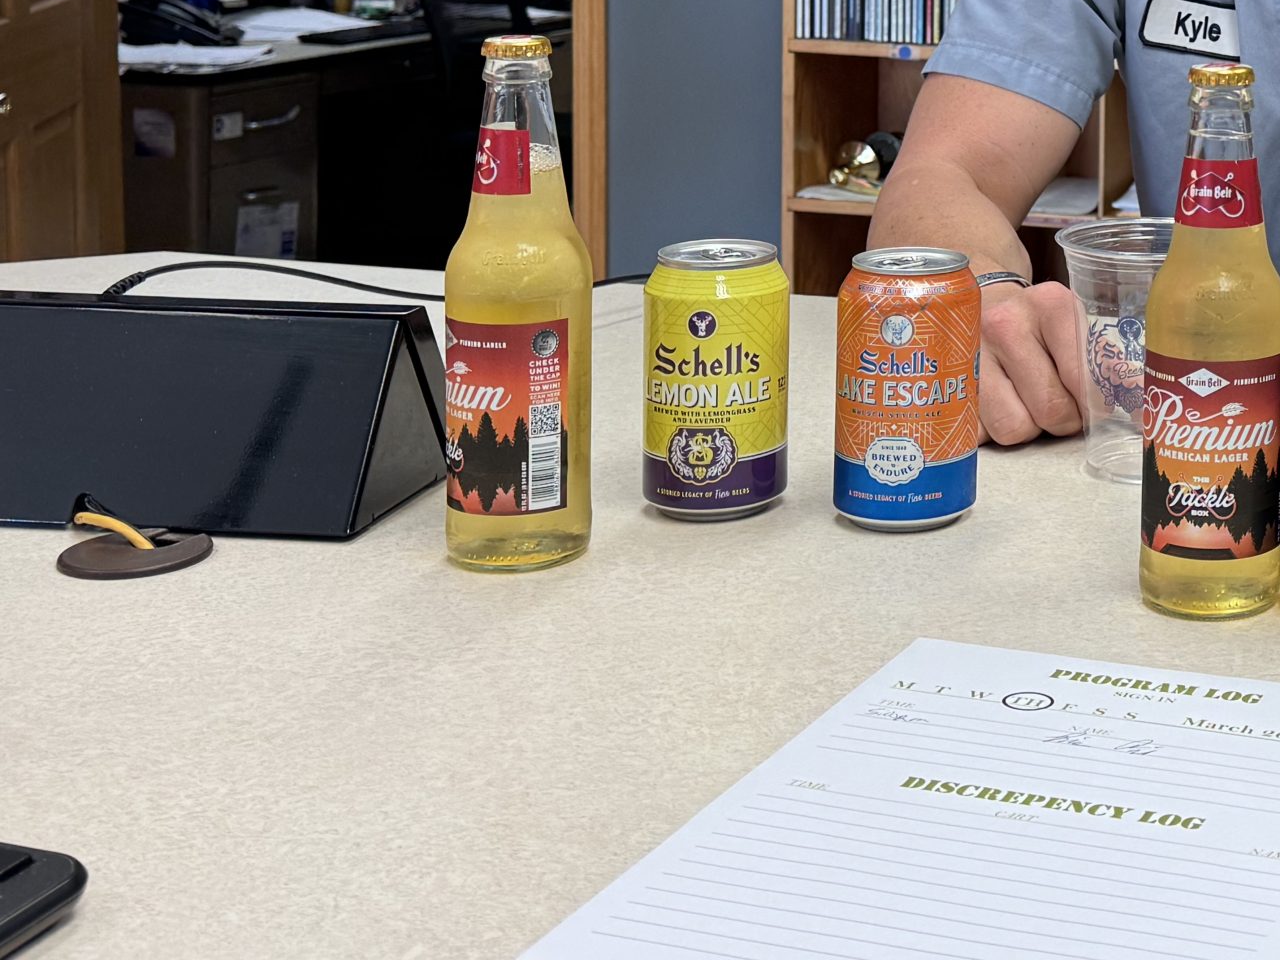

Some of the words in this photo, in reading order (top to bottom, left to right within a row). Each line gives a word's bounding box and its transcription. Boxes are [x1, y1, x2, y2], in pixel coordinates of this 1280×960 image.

[1174, 11, 1222, 42] Kyle
[1190, 184, 1212, 198] Grain
[1214, 185, 1232, 199] Belt
[529, 358, 559, 368] CHECK
[653, 342, 760, 378] Schell's
[857, 349, 938, 376] Schell's
[529, 365, 560, 375] UNDER
[546, 372, 560, 380] CAP
[542, 382, 560, 391] WIN!
[1186, 376, 1206, 387] Grain
[1207, 377, 1222, 388] Belt
[725, 375, 771, 406] ALE
[883, 374, 969, 406] ESCAPE
[451, 410, 473, 421] LAGER
[703, 406, 756, 417] LEMONGRASS
[1143, 386, 1277, 451] Premium
[871, 453, 917, 462] BREWED
[1159, 448, 1210, 462] AMERICAN
[1214, 452, 1248, 463] LAGER
[873, 463, 915, 477] ENDURE
[874, 494, 896, 502] LEGACY
[1169, 482, 1235, 508] Tackle
[1049, 668, 1198, 697] PROGRAM
[1202, 686, 1264, 705] LOG
[880, 699, 916, 708] TIME
[1113, 691, 1154, 702] SIGN
[1156, 696, 1177, 704] IN
[891, 680, 916, 690] M
[935, 685, 951, 694] T
[970, 690, 993, 699] W
[1012, 696, 1046, 708] TH
[1061, 703, 1078, 711] F
[1092, 707, 1107, 717] S
[1123, 711, 1138, 720] S
[1182, 716, 1254, 736] March
[1069, 725, 1113, 736] NAME
[786, 779, 830, 791] TIME
[899, 776, 1134, 821] DISCREPENCY
[1138, 810, 1207, 831] LOG
[994, 810, 1039, 823] CART
